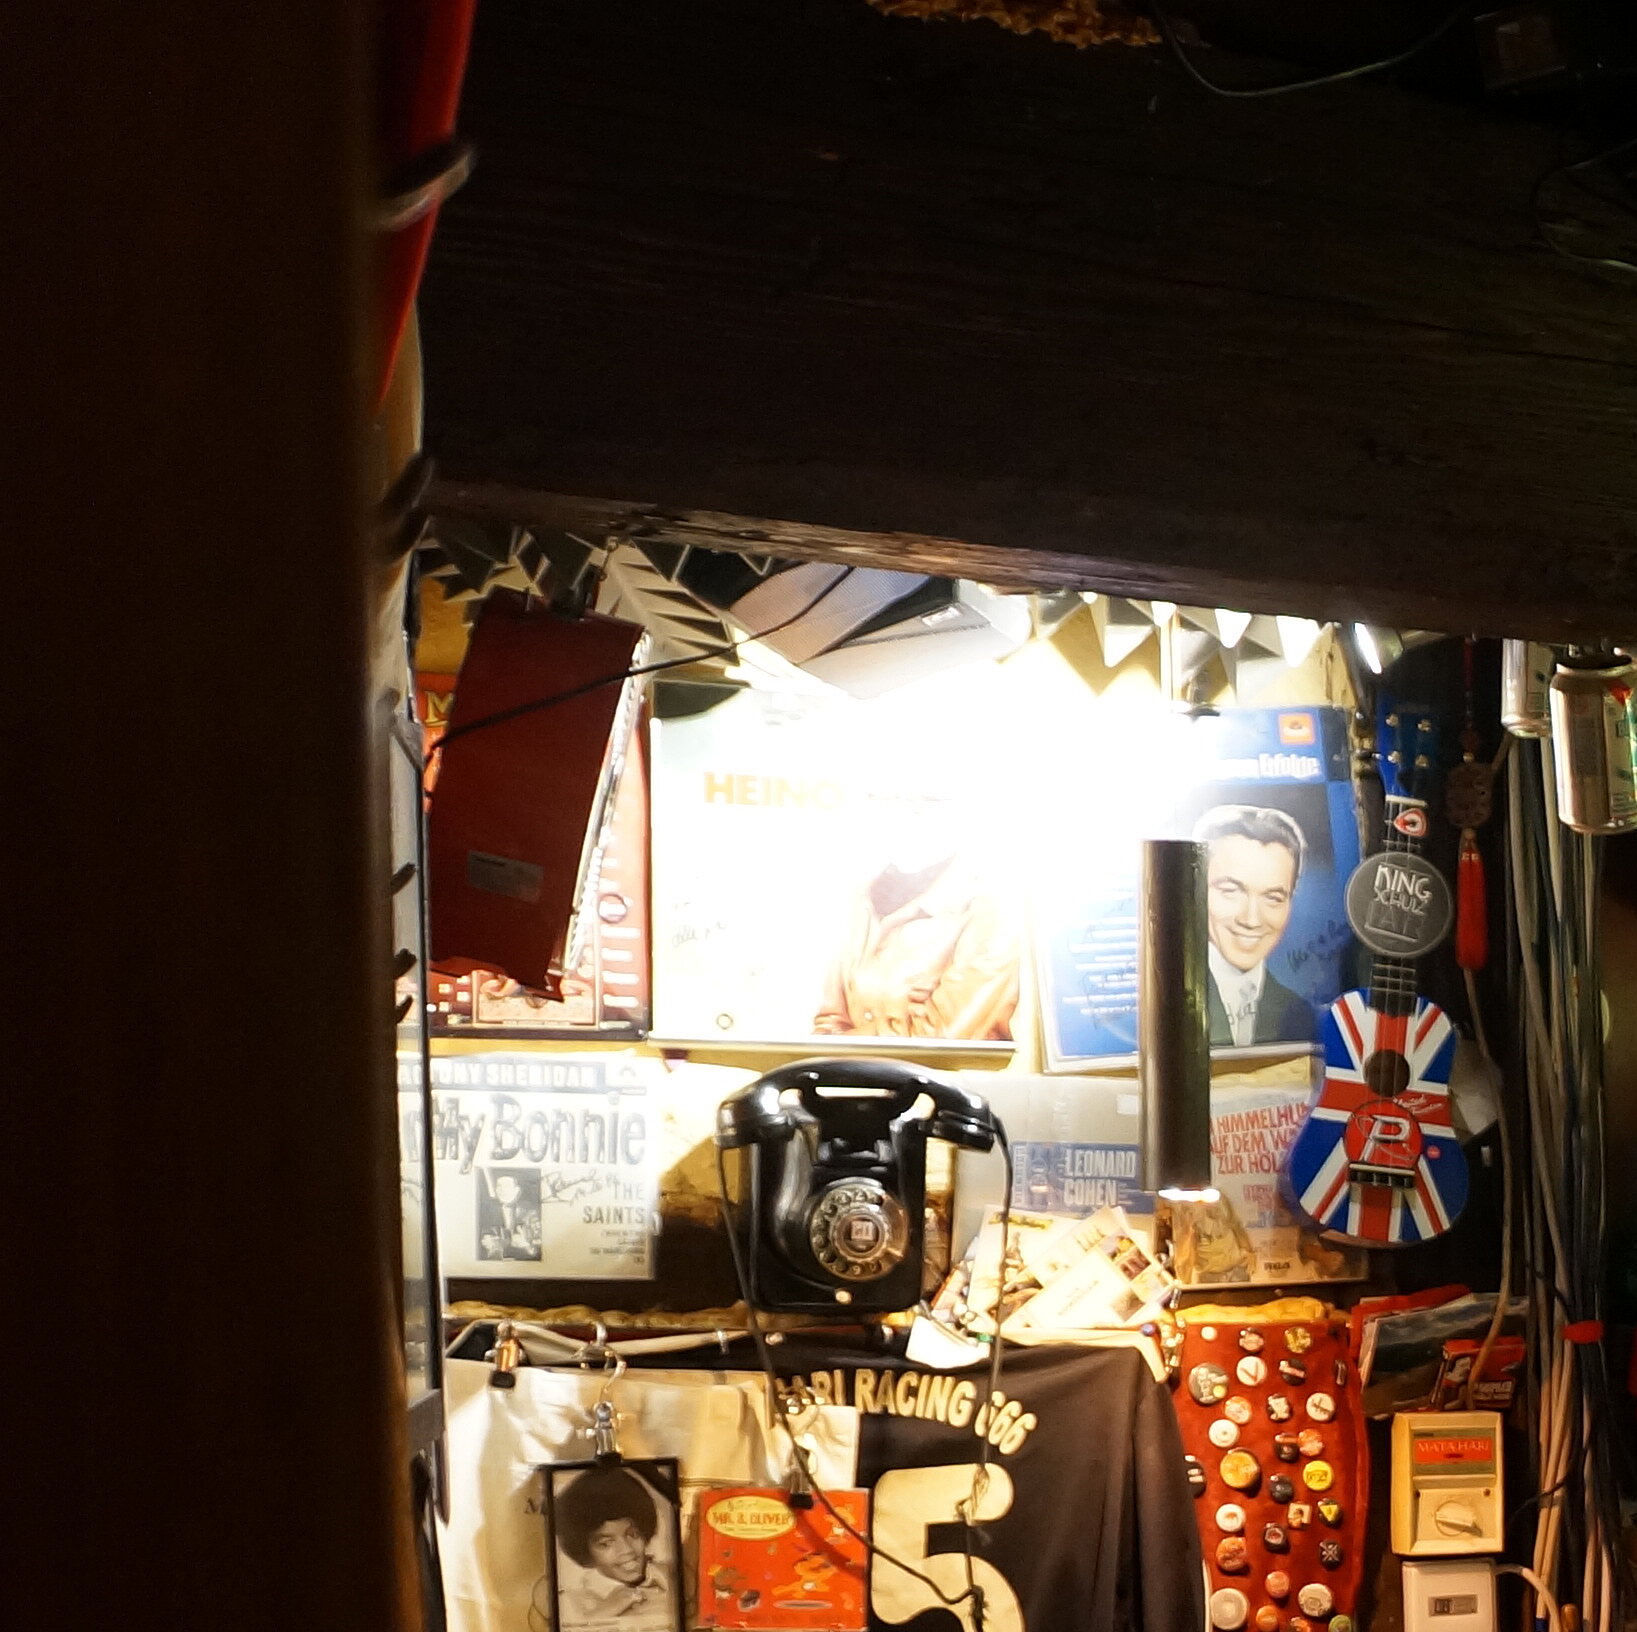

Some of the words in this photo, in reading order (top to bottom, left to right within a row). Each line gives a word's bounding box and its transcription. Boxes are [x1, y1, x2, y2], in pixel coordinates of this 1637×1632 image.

[702, 771, 845, 811] HEINO
[1374, 864, 1432, 901] KING
[486, 1063, 596, 1088] SHERIDAN
[489, 1090, 647, 1167] Bonnie
[1232, 1129, 1266, 1154] DEM
[1064, 1148, 1137, 1178] LEONARD
[1217, 1153, 1244, 1175] ZUR
[612, 1181, 645, 1201] THE
[1063, 1177, 1119, 1206] COHEN
[581, 1204, 646, 1225] SAINTS
[854, 1368, 977, 1428] RACING
